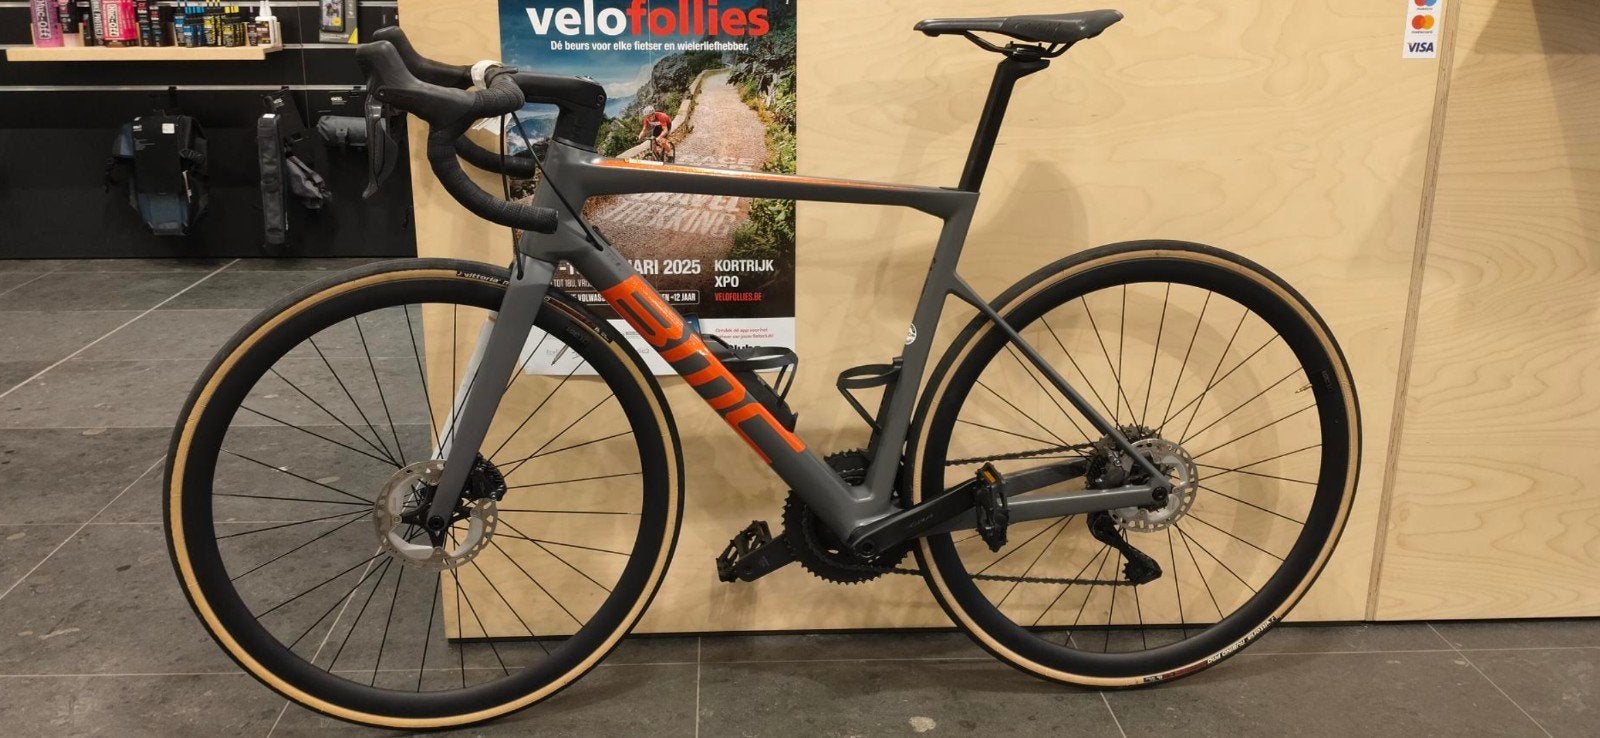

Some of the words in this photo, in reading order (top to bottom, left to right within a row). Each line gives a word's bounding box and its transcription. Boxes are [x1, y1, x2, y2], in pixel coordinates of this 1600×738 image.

[526, 0, 770, 36] velofollies
[550, 41, 563, 51] Dé
[565, 41, 590, 51] beurs
[592, 43, 612, 51] voor
[613, 41, 632, 51] elke
[634, 41, 662, 51] fietser
[664, 43, 675, 51] en
[677, 41, 750, 51] wielerliefhebber.
[1407, 42, 1434, 53] VISA
[662, 259, 701, 275] 2025
[714, 259, 775, 272] KORTRIJK
[553, 279, 564, 287] TOT
[714, 275, 740, 288] XPO
[681, 292, 697, 301] JAAR
[714, 292, 763, 301] VELOFOLLIES.BE
[601, 274, 807, 465] BMC
